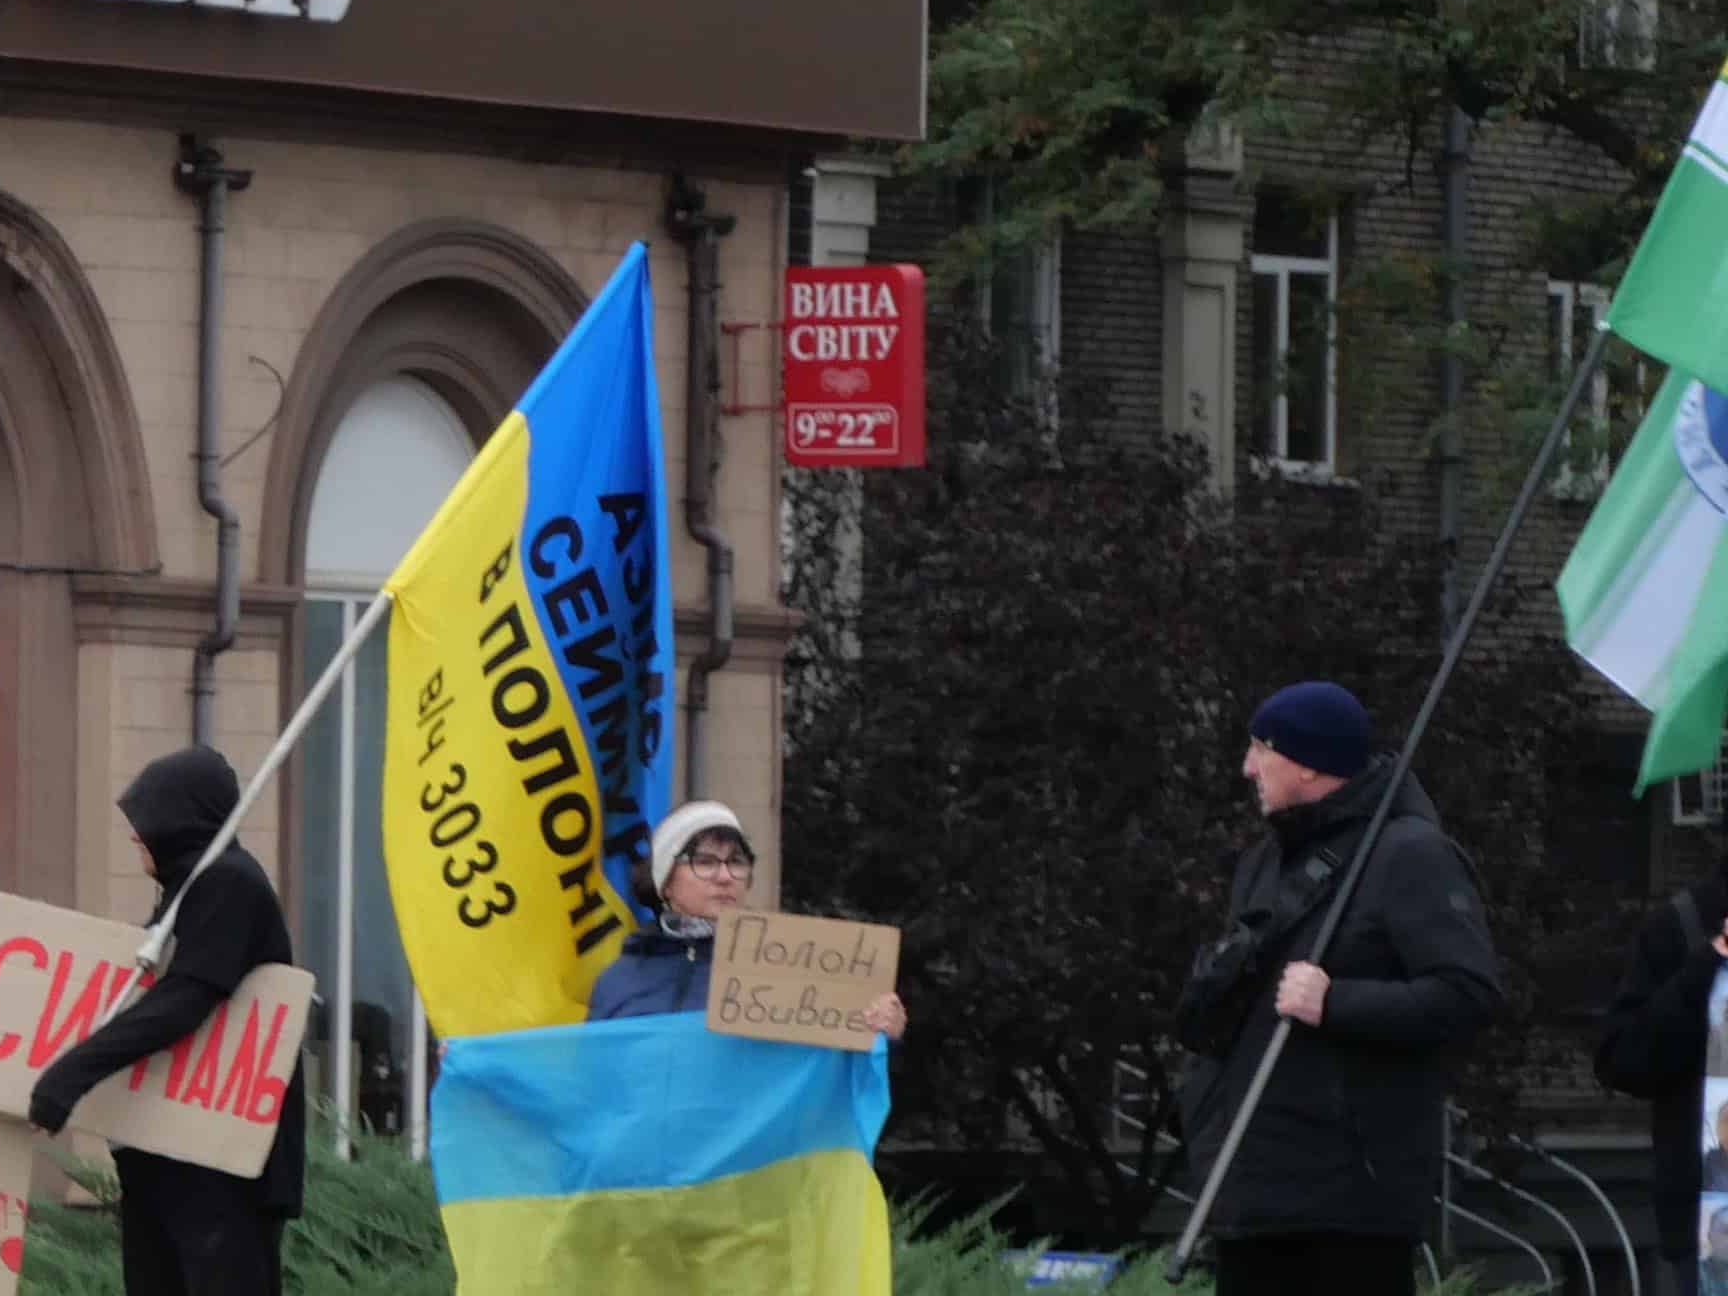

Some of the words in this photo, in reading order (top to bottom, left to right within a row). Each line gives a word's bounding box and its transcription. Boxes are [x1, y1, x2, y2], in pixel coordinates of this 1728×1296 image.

[791, 282, 899, 318] ВИНА
[789, 325, 900, 361] СВІТУ
[479, 601, 623, 958] ПОЛОНІ
[419, 762, 518, 930] 3033
[728, 915, 877, 977] Полон
